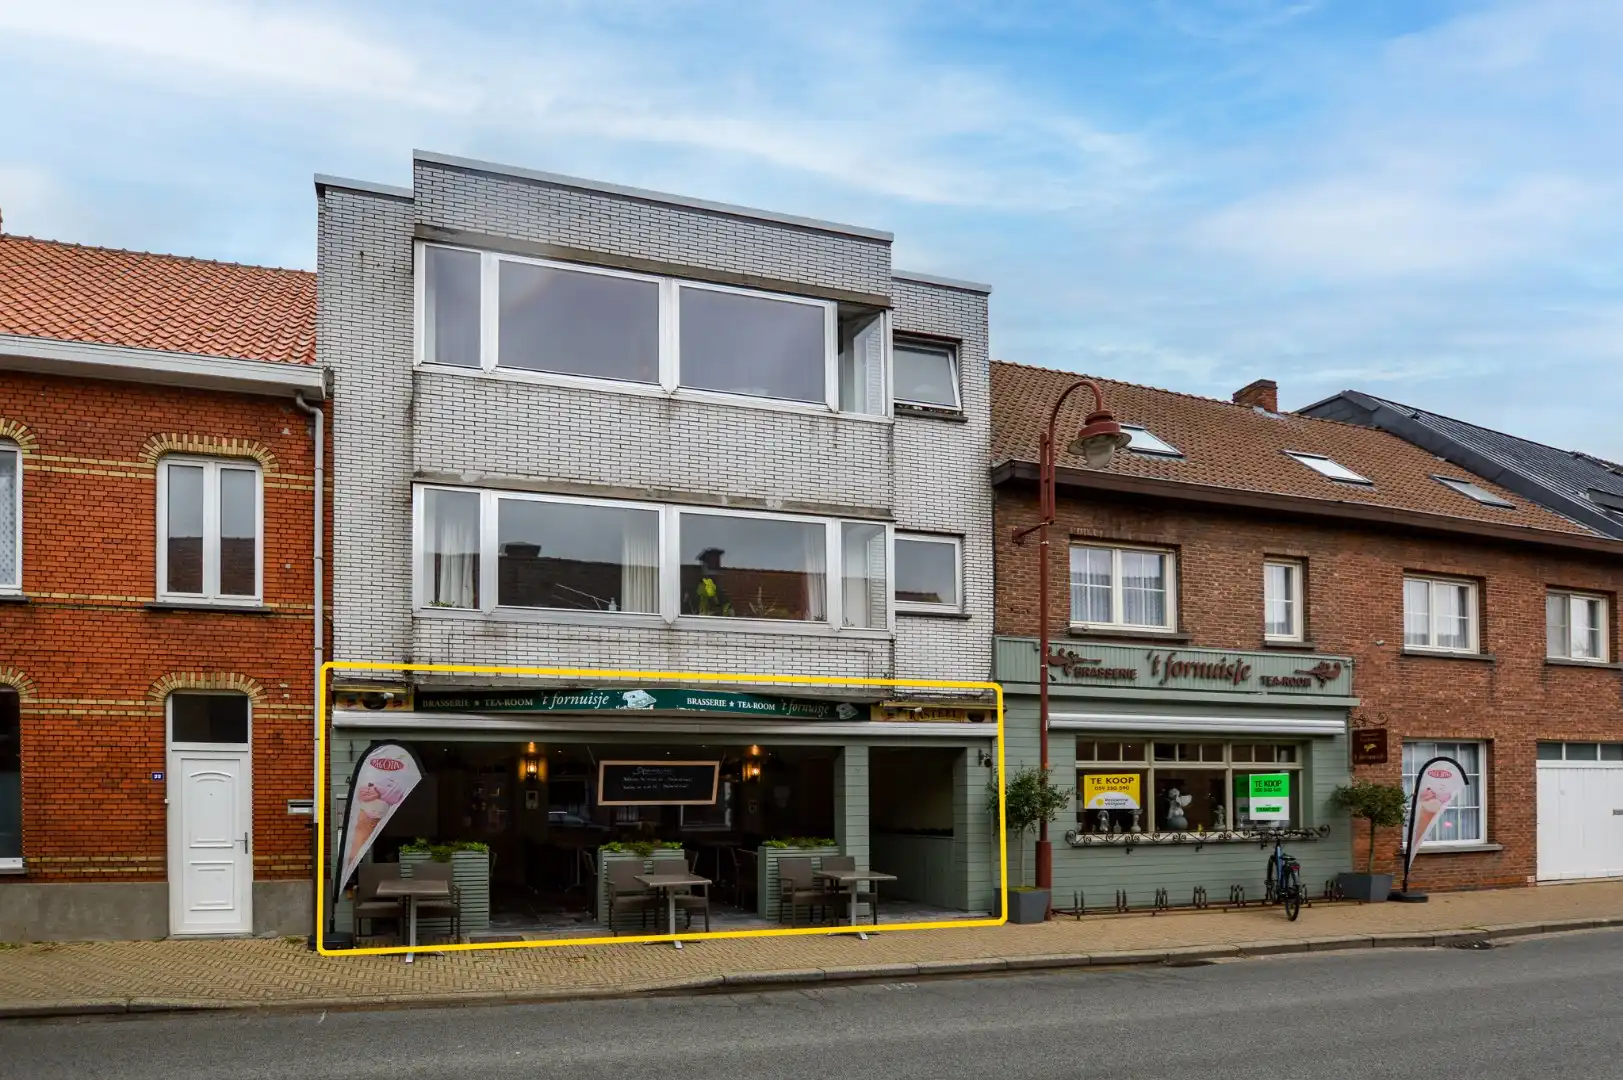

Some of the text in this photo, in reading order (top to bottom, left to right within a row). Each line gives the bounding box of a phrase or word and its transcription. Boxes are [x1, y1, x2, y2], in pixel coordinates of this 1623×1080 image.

[1073, 666, 1138, 681] BRASSERIE
[1159, 651, 1252, 686] fornuisje
[1259, 675, 1312, 688] TEA-ROOM
[422, 699, 470, 708] BRASSERIE
[484, 698, 534, 707] TEA-ROOM
[548, 691, 610, 710] fornuisje
[686, 697, 727, 707] BRASSERIE
[737, 700, 776, 711] TEA-ROOM
[785, 699, 830, 718] fornuisje
[1105, 776, 1135, 784] KOOP
[1254, 779, 1282, 788] TE KOOP
